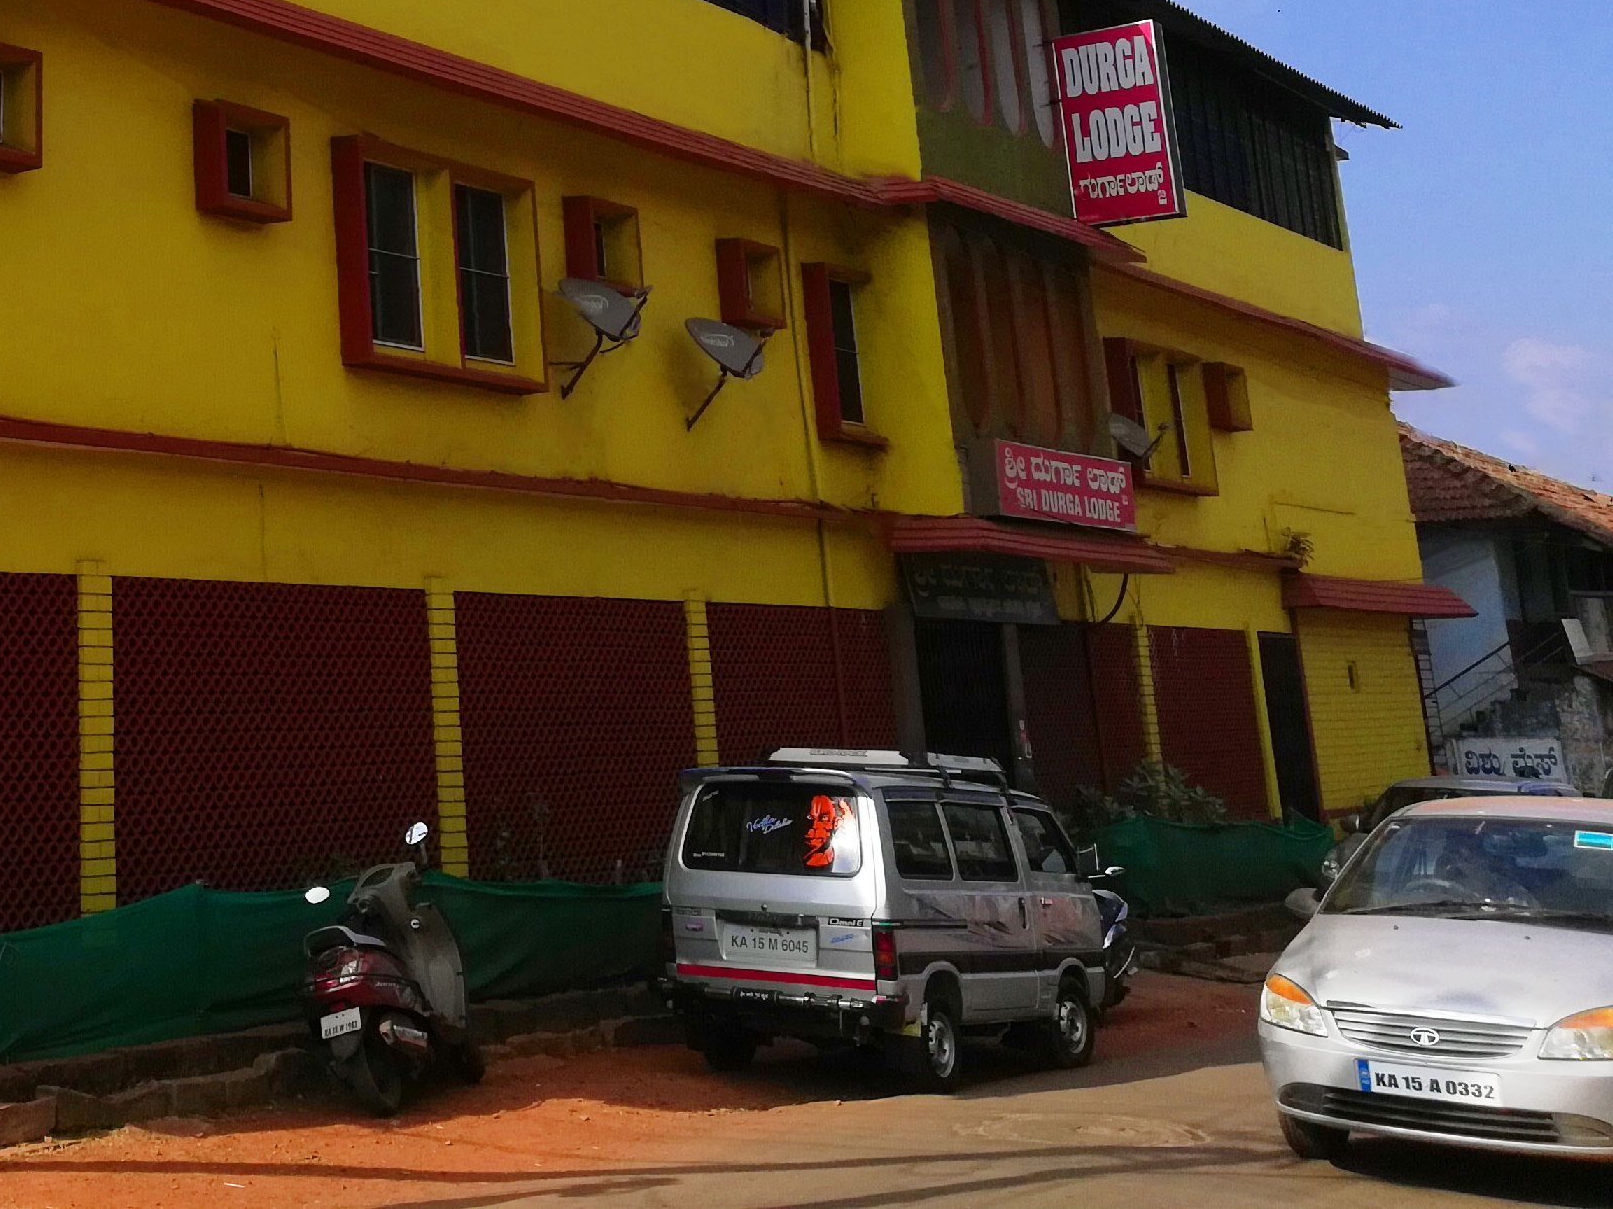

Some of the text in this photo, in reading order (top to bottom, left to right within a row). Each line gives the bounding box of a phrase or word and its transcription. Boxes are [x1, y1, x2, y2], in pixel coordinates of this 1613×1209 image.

[1061, 35, 1155, 98] DURGA
[1071, 100, 1162, 164] LODGE
[1016, 487, 1121, 522] SRI DURGA LODGE
[731, 935, 809, 953] KA 15 M 6045
[1375, 1071, 1399, 1089] KA
[1401, 1076, 1423, 1092] 15
[1429, 1078, 1442, 1094] A
[1445, 1080, 1495, 1100] 0332
